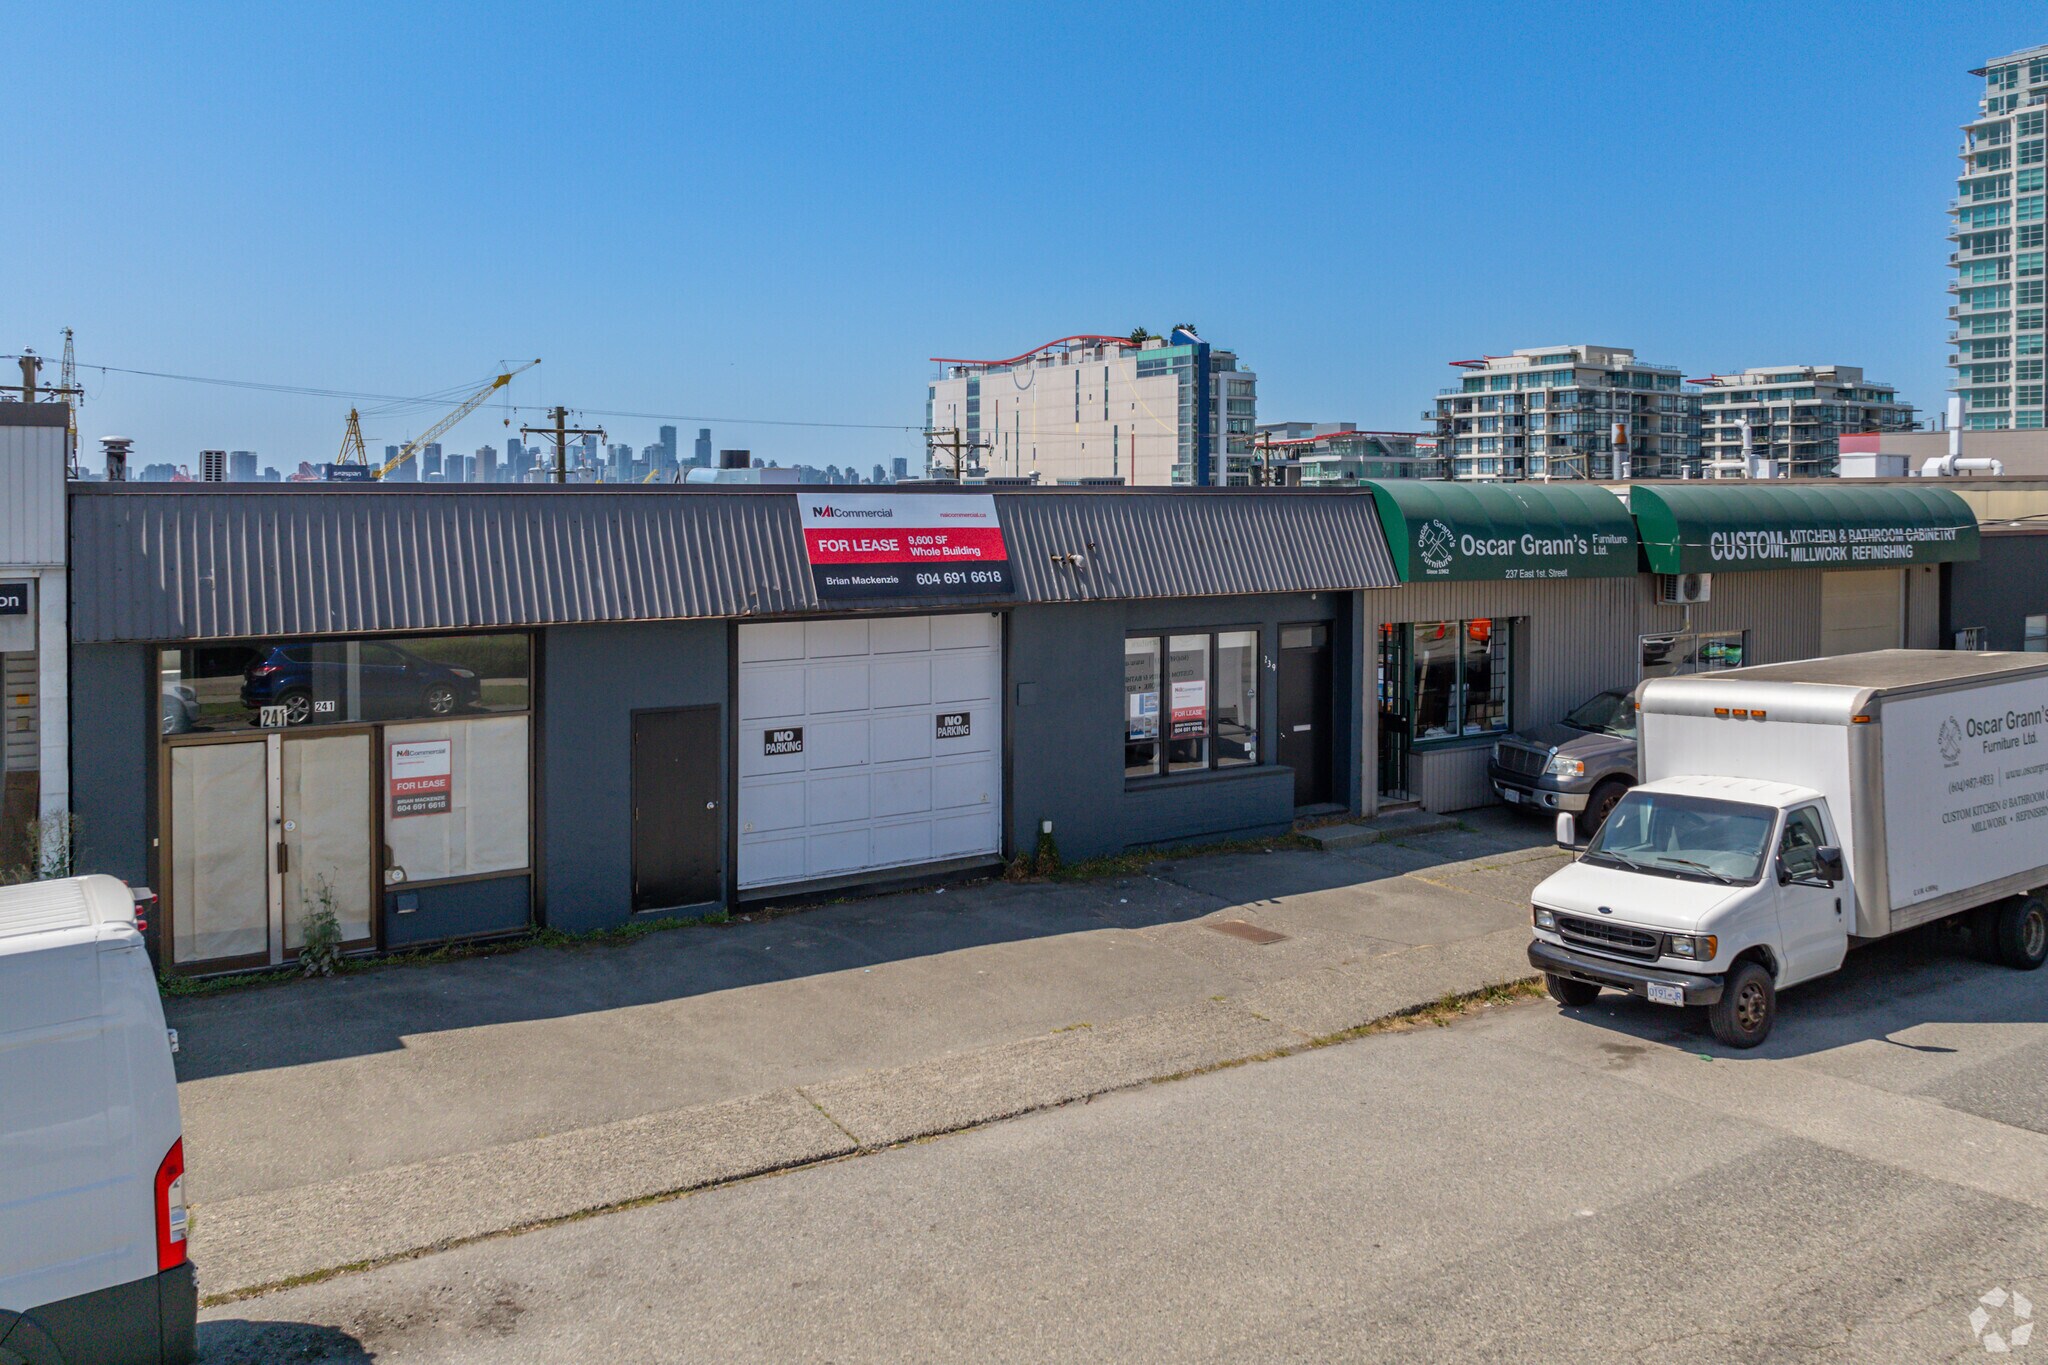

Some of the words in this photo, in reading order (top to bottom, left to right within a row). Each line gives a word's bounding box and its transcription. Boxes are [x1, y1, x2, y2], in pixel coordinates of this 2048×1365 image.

[1418, 522, 1429, 548] Oscar
[1433, 519, 1456, 548] Grann's
[1592, 533, 1628, 544] Furniture
[1789, 528, 1837, 544] KITCHEN
[1839, 529, 1848, 543] &
[1848, 528, 1905, 543] BATHROOM
[1905, 527, 1956, 543] CABINETRY
[817, 539, 850, 553] FOR
[852, 538, 900, 552] LEASE
[907, 535, 934, 547] 9,600
[935, 535, 948, 545] SF
[1460, 533, 1516, 556] Oscar
[1520, 533, 1587, 556] Grann's
[909, 546, 942, 557] Whole
[942, 546, 981, 557] Building
[1593, 544, 1609, 556] Ltd.
[1790, 545, 1848, 562] MILLWORK
[1852, 544, 1914, 560] REFINISHING
[1420, 551, 1453, 569] Furniture
[825, 576, 850, 586] Brian
[851, 575, 899, 585] Mackenzie
[916, 573, 941, 585] 604
[943, 572, 967, 584] 691
[970, 571, 1002, 583] 6618
[1505, 569, 1519, 579] 237
[1519, 569, 1535, 578] East
[1548, 568, 1568, 578] Street
[1264, 655, 1276, 671] 239
[315, 702, 333, 711] 241
[1186, 709, 1203, 717] LEASE
[262, 709, 285, 727] 241
[945, 715, 963, 726] NO
[937, 725, 970, 737] PARKING
[1966, 717, 2003, 738] Oscar
[773, 731, 794, 742] NO
[1983, 736, 2020, 754] Furniture
[2022, 730, 2038, 745] Ltd.
[765, 740, 802, 754] PARKING
[396, 781, 416, 791] FOR
[417, 779, 446, 789] LEASE
[397, 804, 412, 812] 604
[428, 801, 446, 809] 6618
[1941, 807, 1971, 824] CUSTOM
[1972, 801, 2001, 817] KITCHEN
[2008, 791, 2045, 808] BATHROOM
[1971, 815, 2008, 833] MILLWORK
